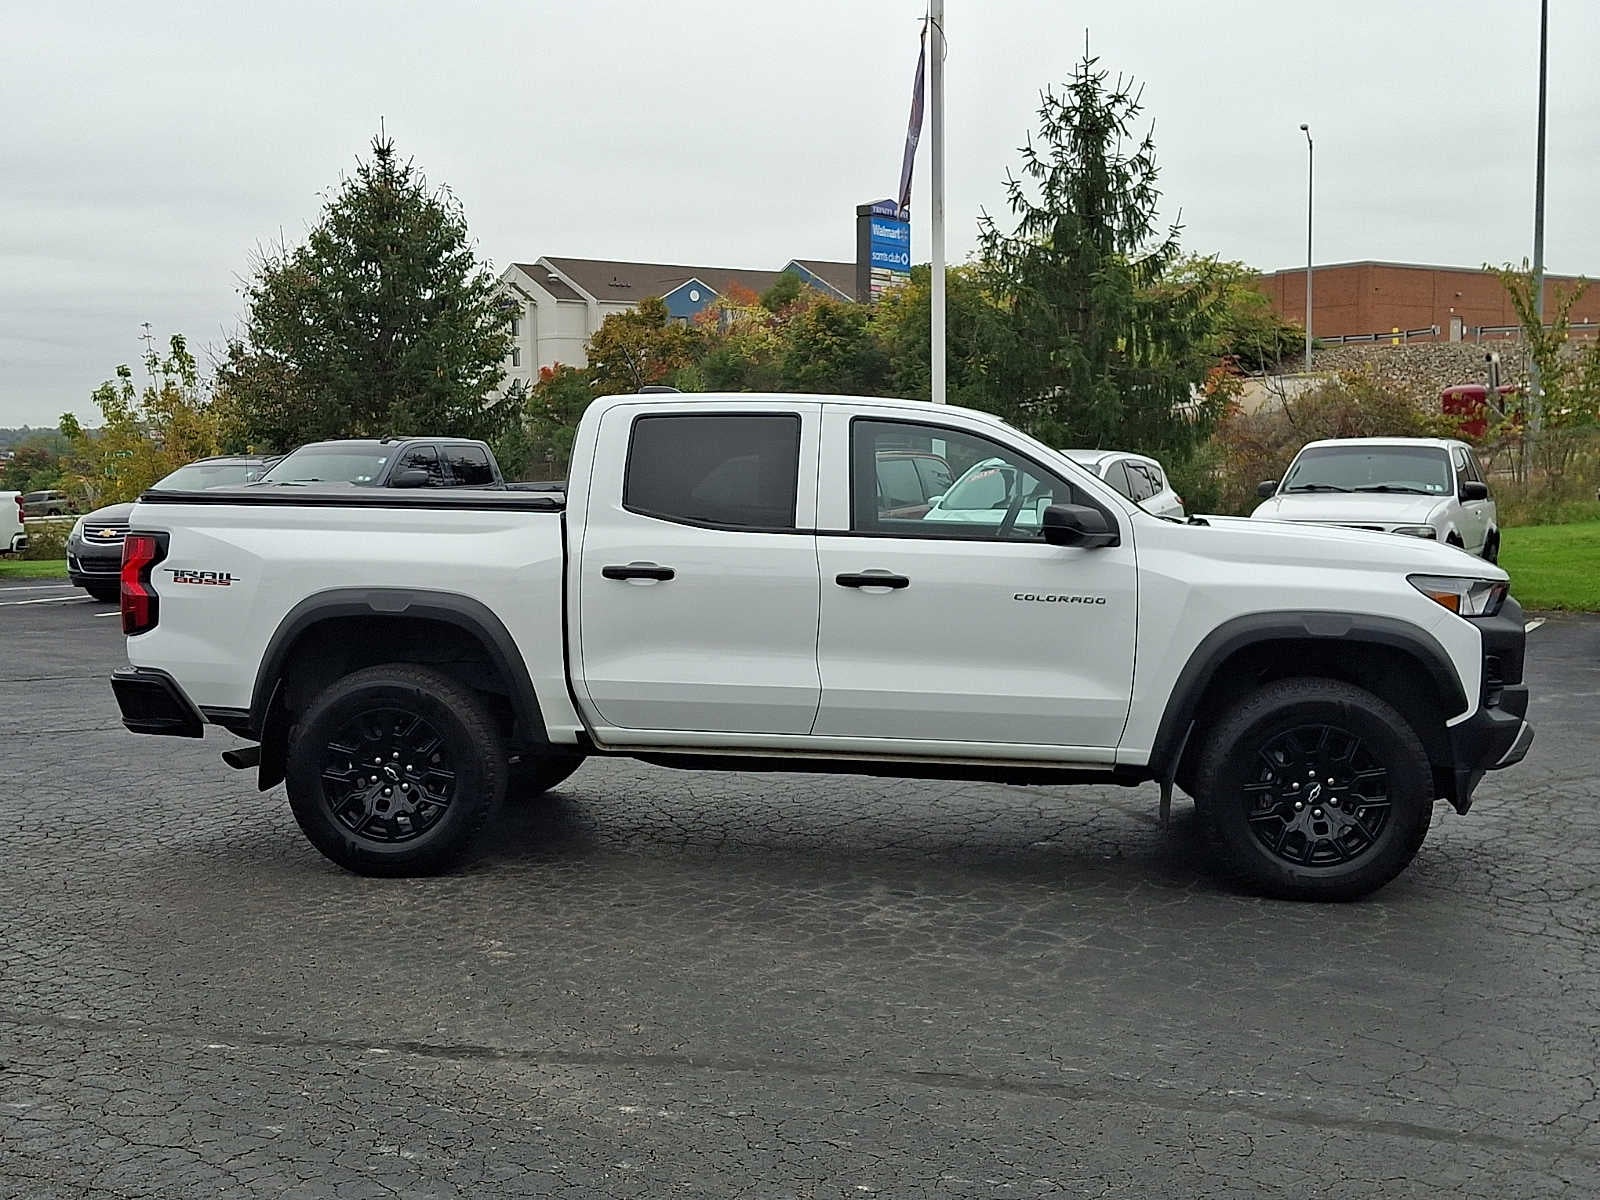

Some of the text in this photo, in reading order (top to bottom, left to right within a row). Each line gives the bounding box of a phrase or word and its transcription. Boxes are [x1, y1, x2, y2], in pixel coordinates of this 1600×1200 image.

[872, 223, 900, 239] Walmart
[889, 252, 900, 264] club
[164, 568, 240, 582] TRAIL
[173, 577, 231, 587] BOSS
[1013, 593, 1107, 605] COLORADO
